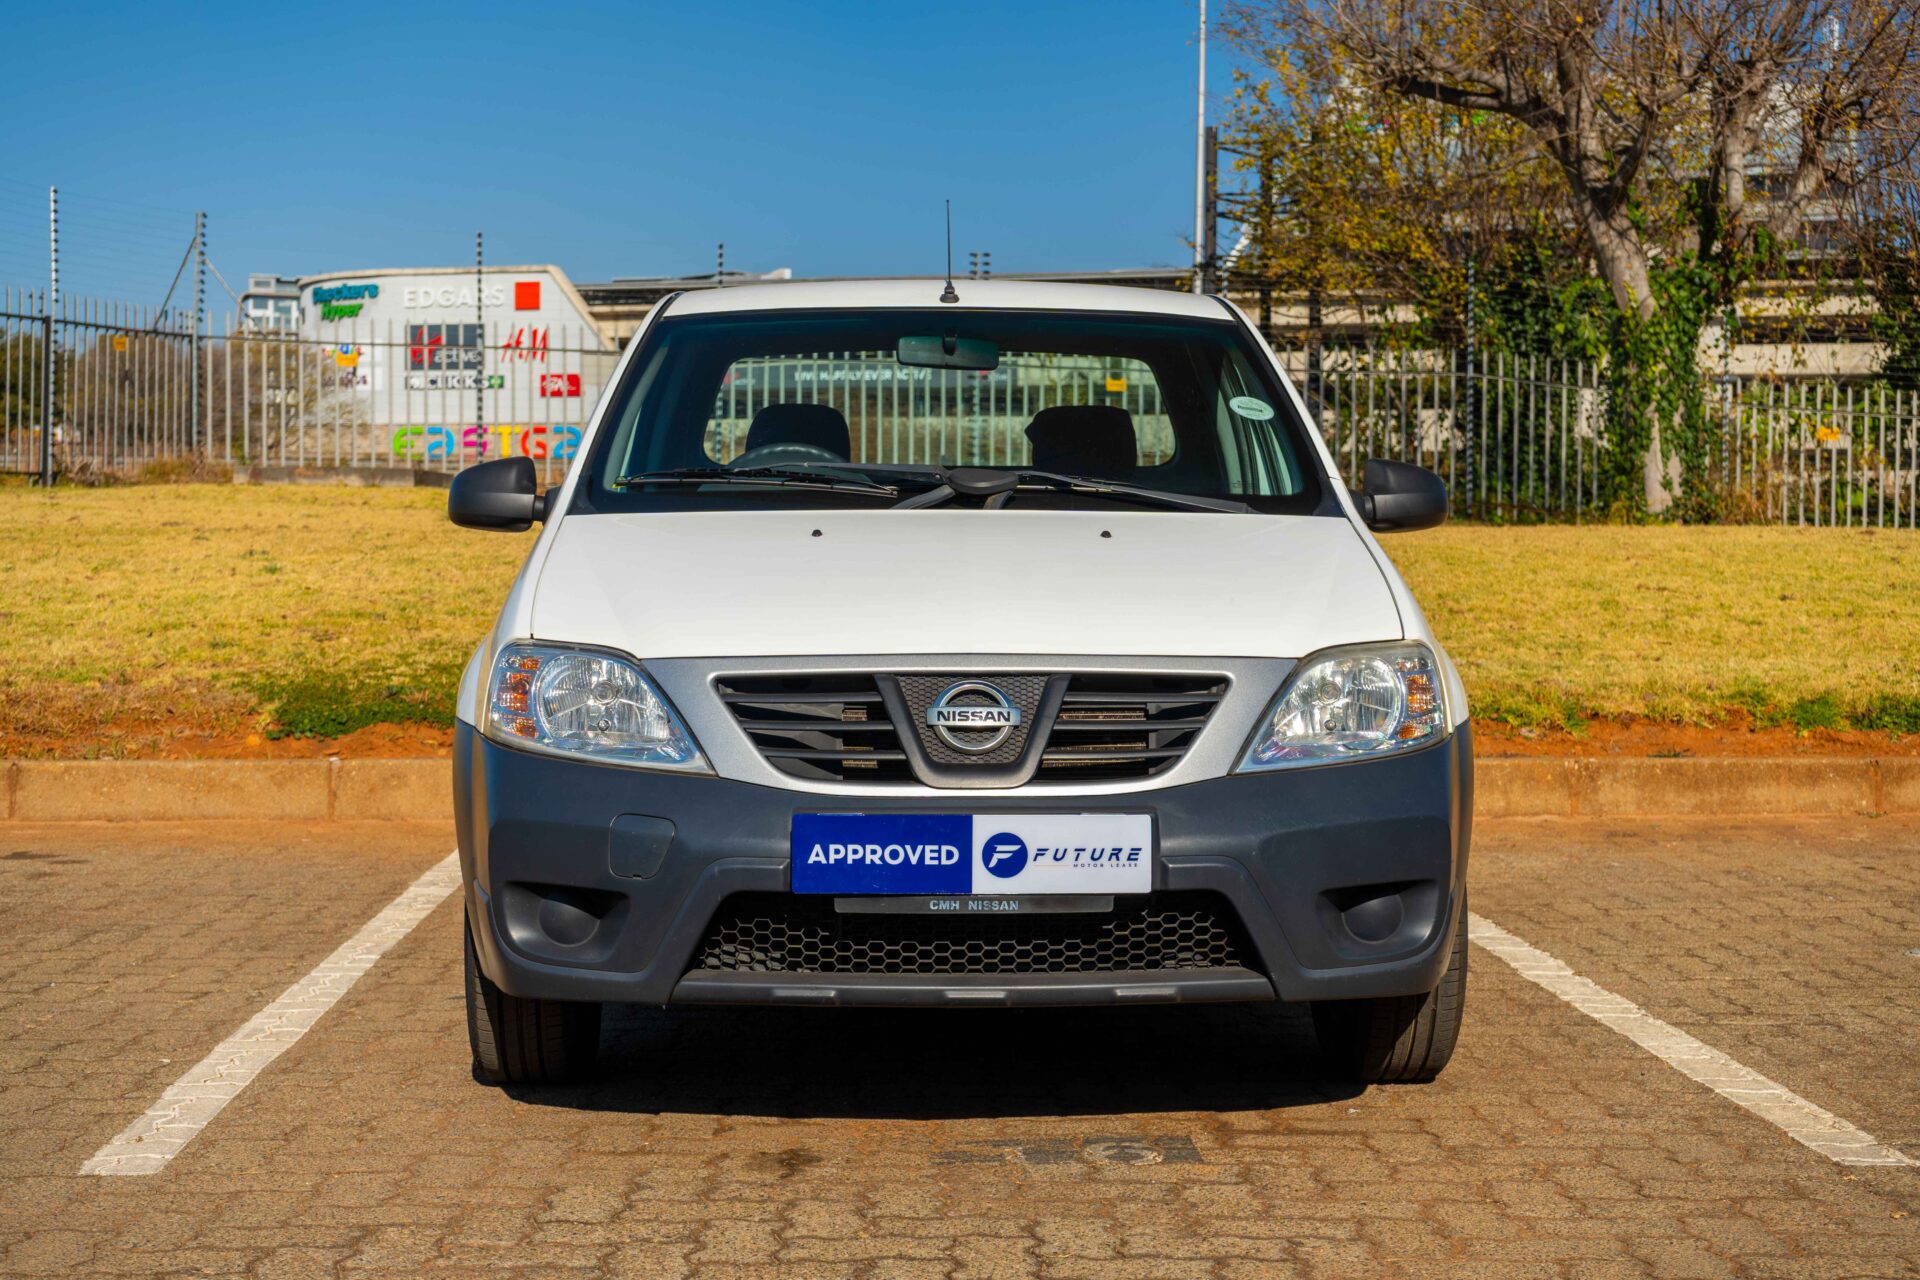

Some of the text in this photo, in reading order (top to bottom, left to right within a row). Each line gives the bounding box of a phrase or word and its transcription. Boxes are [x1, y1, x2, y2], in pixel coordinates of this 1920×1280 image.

[937, 710, 1011, 722] NISSAN
[807, 844, 960, 866] APPROVED
[1033, 848, 1142, 862] FUTURE
[929, 900, 1019, 910] CMH NISSAN
